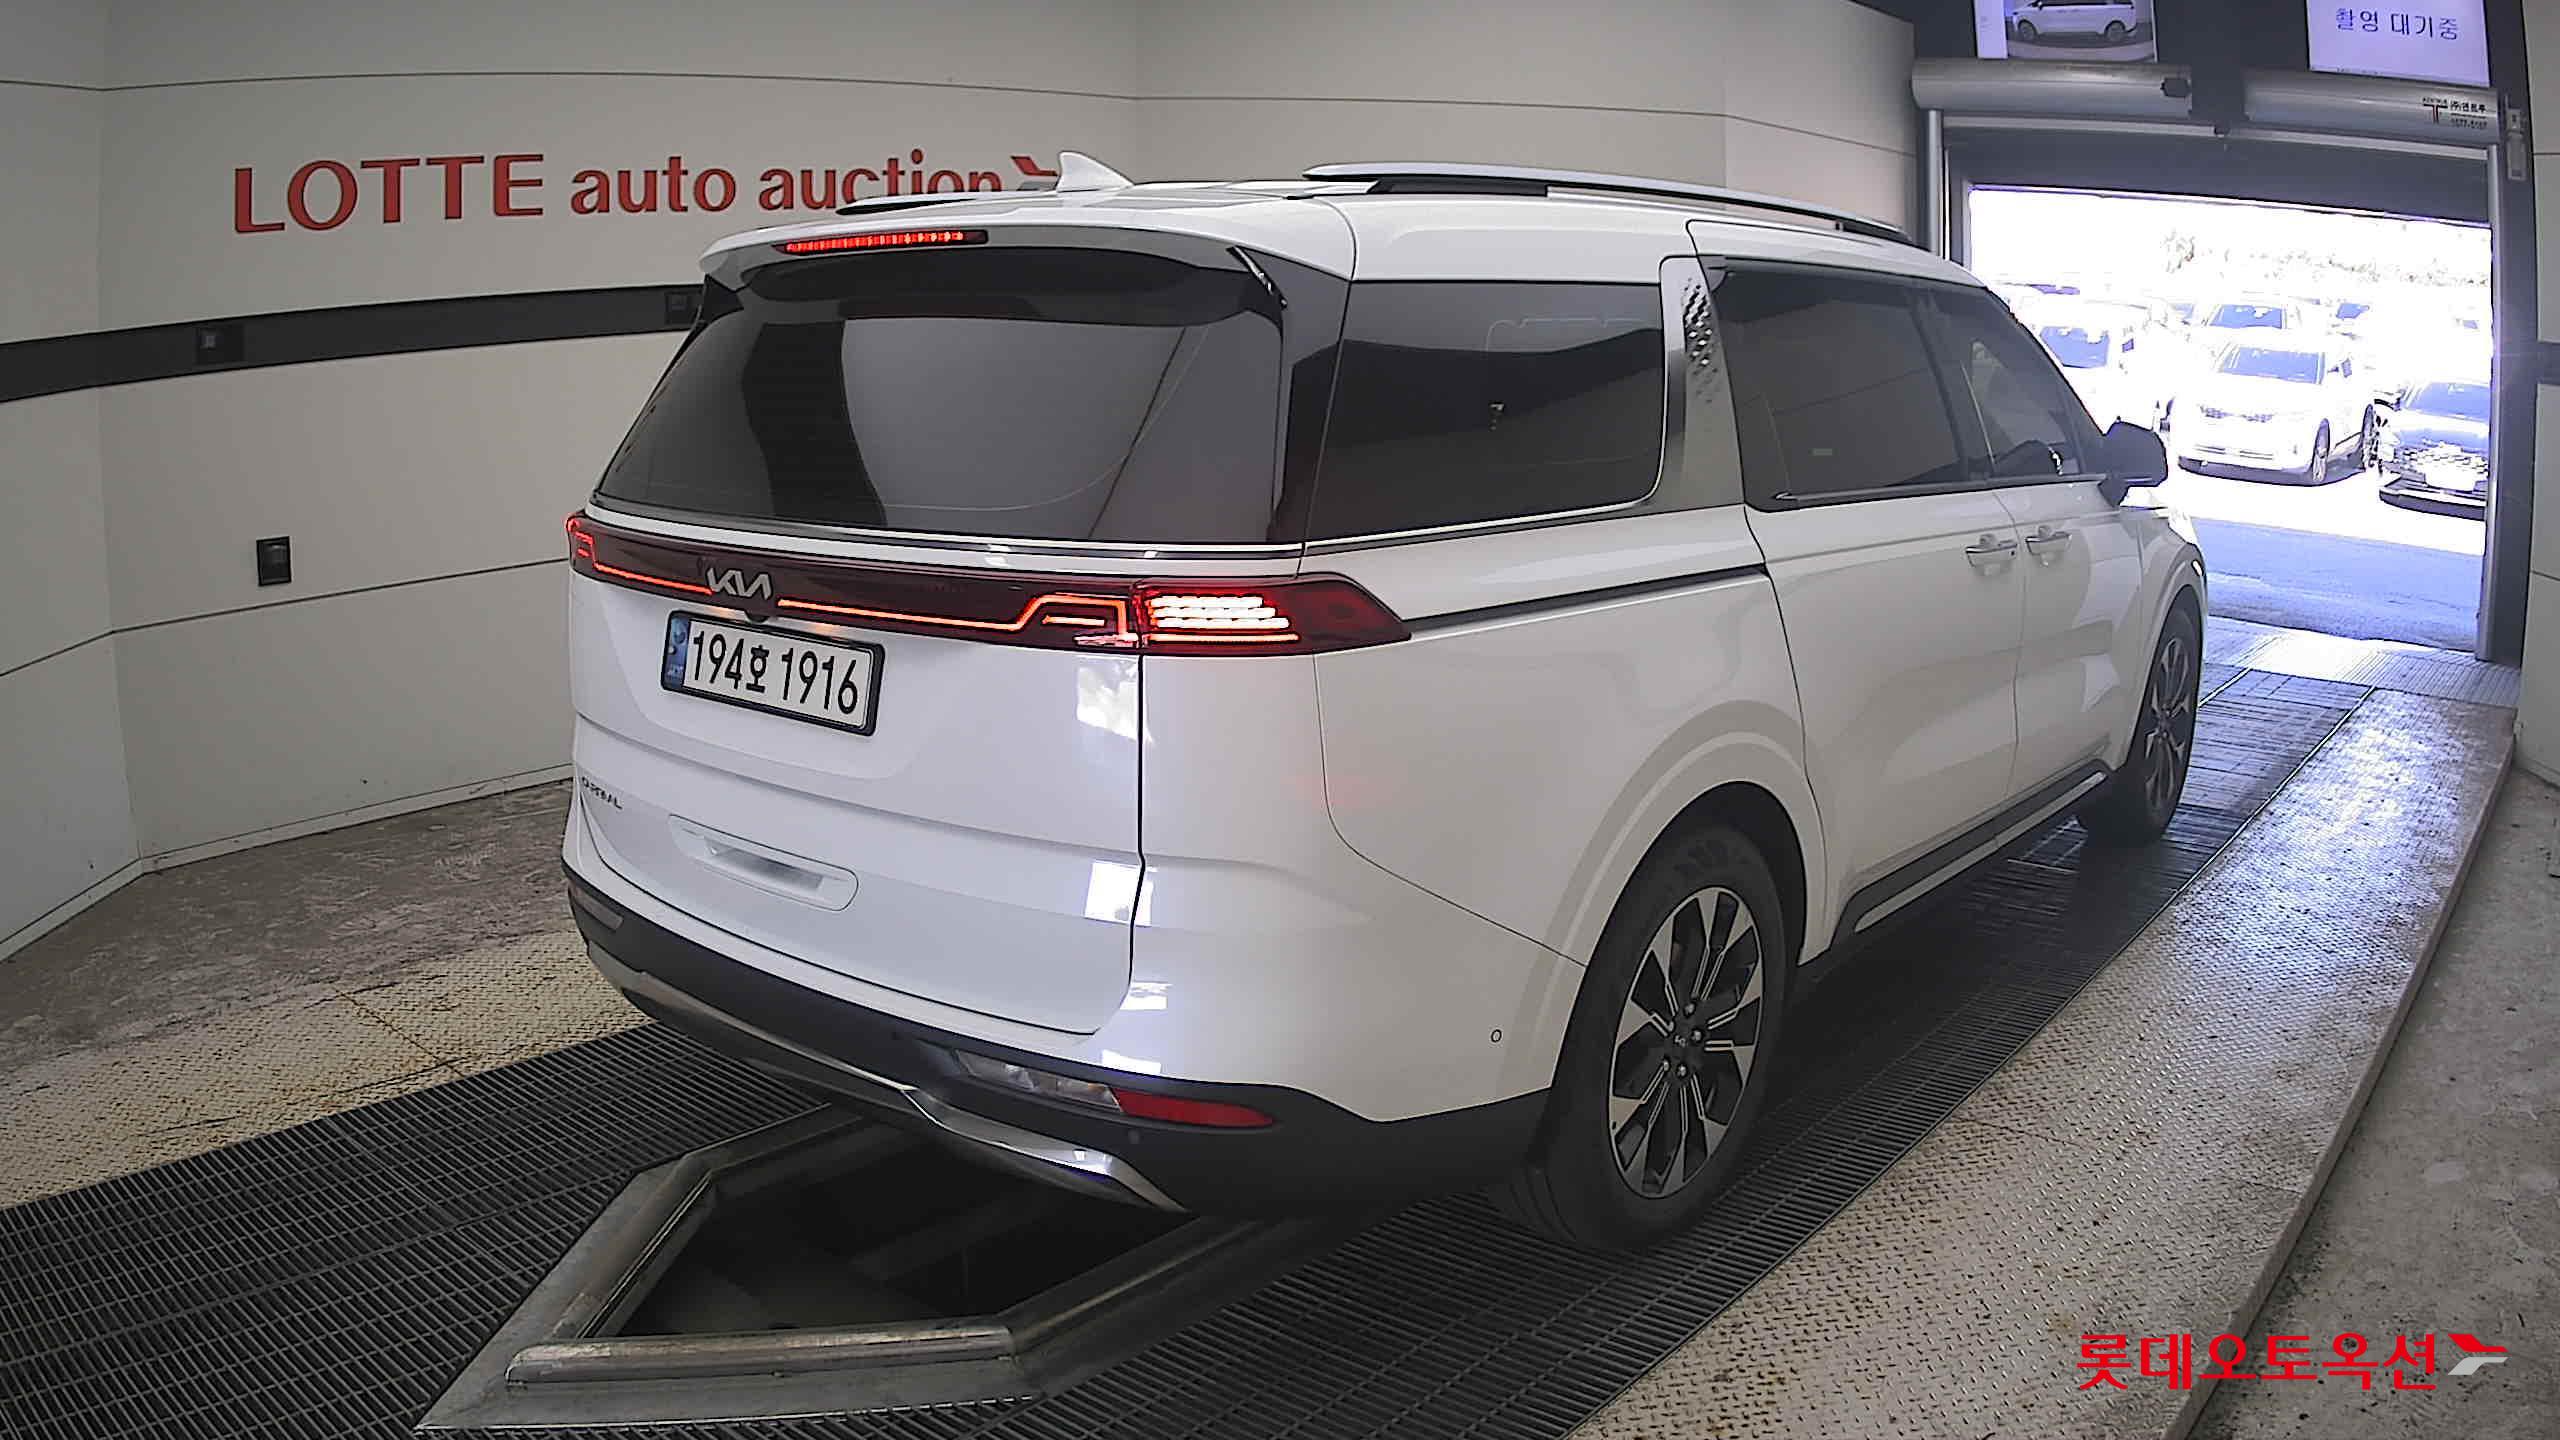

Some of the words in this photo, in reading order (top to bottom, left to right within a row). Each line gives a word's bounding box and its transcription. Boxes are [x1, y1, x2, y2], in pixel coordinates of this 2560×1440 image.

[235, 154, 543, 233] LOTTE
[571, 155, 736, 214] auto
[693, 630, 770, 694] 194호
[781, 647, 858, 715] 1916
